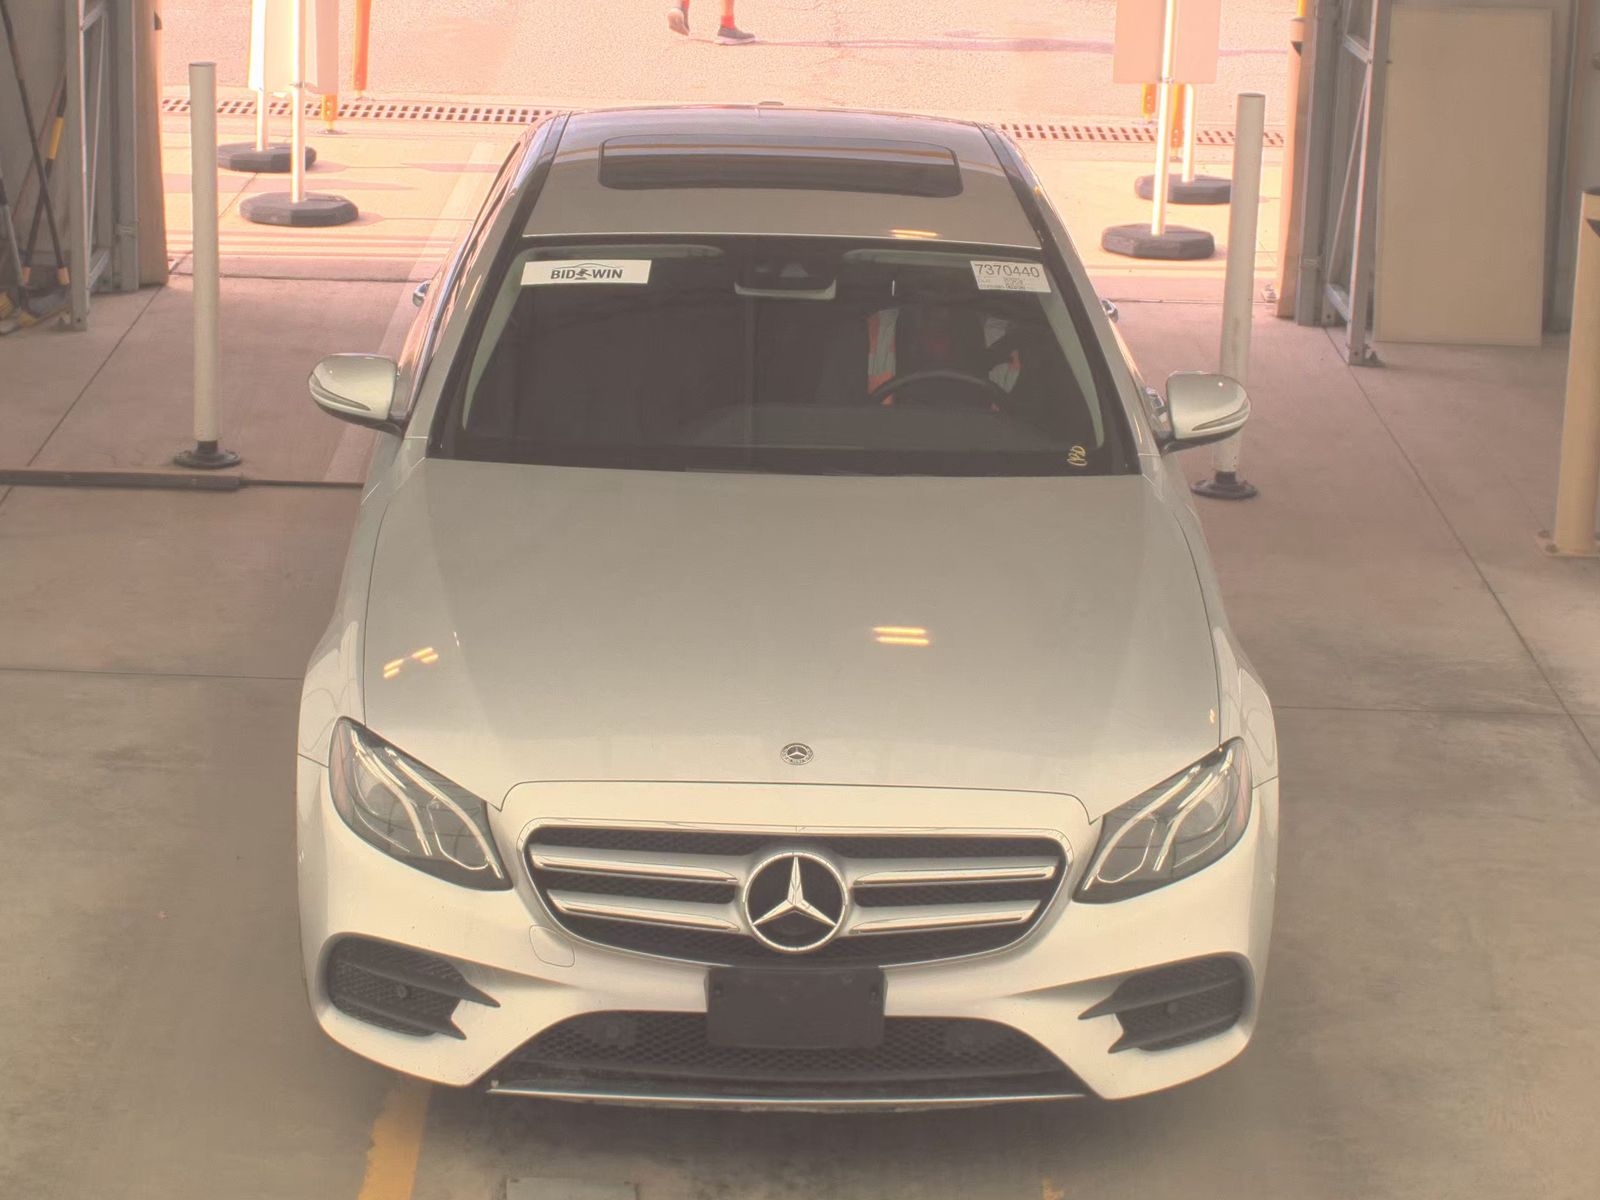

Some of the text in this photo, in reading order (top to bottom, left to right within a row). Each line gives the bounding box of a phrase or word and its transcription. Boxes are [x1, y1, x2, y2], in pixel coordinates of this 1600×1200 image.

[550, 268, 623, 280] BID WIN
[974, 263, 1040, 278] 7370440
